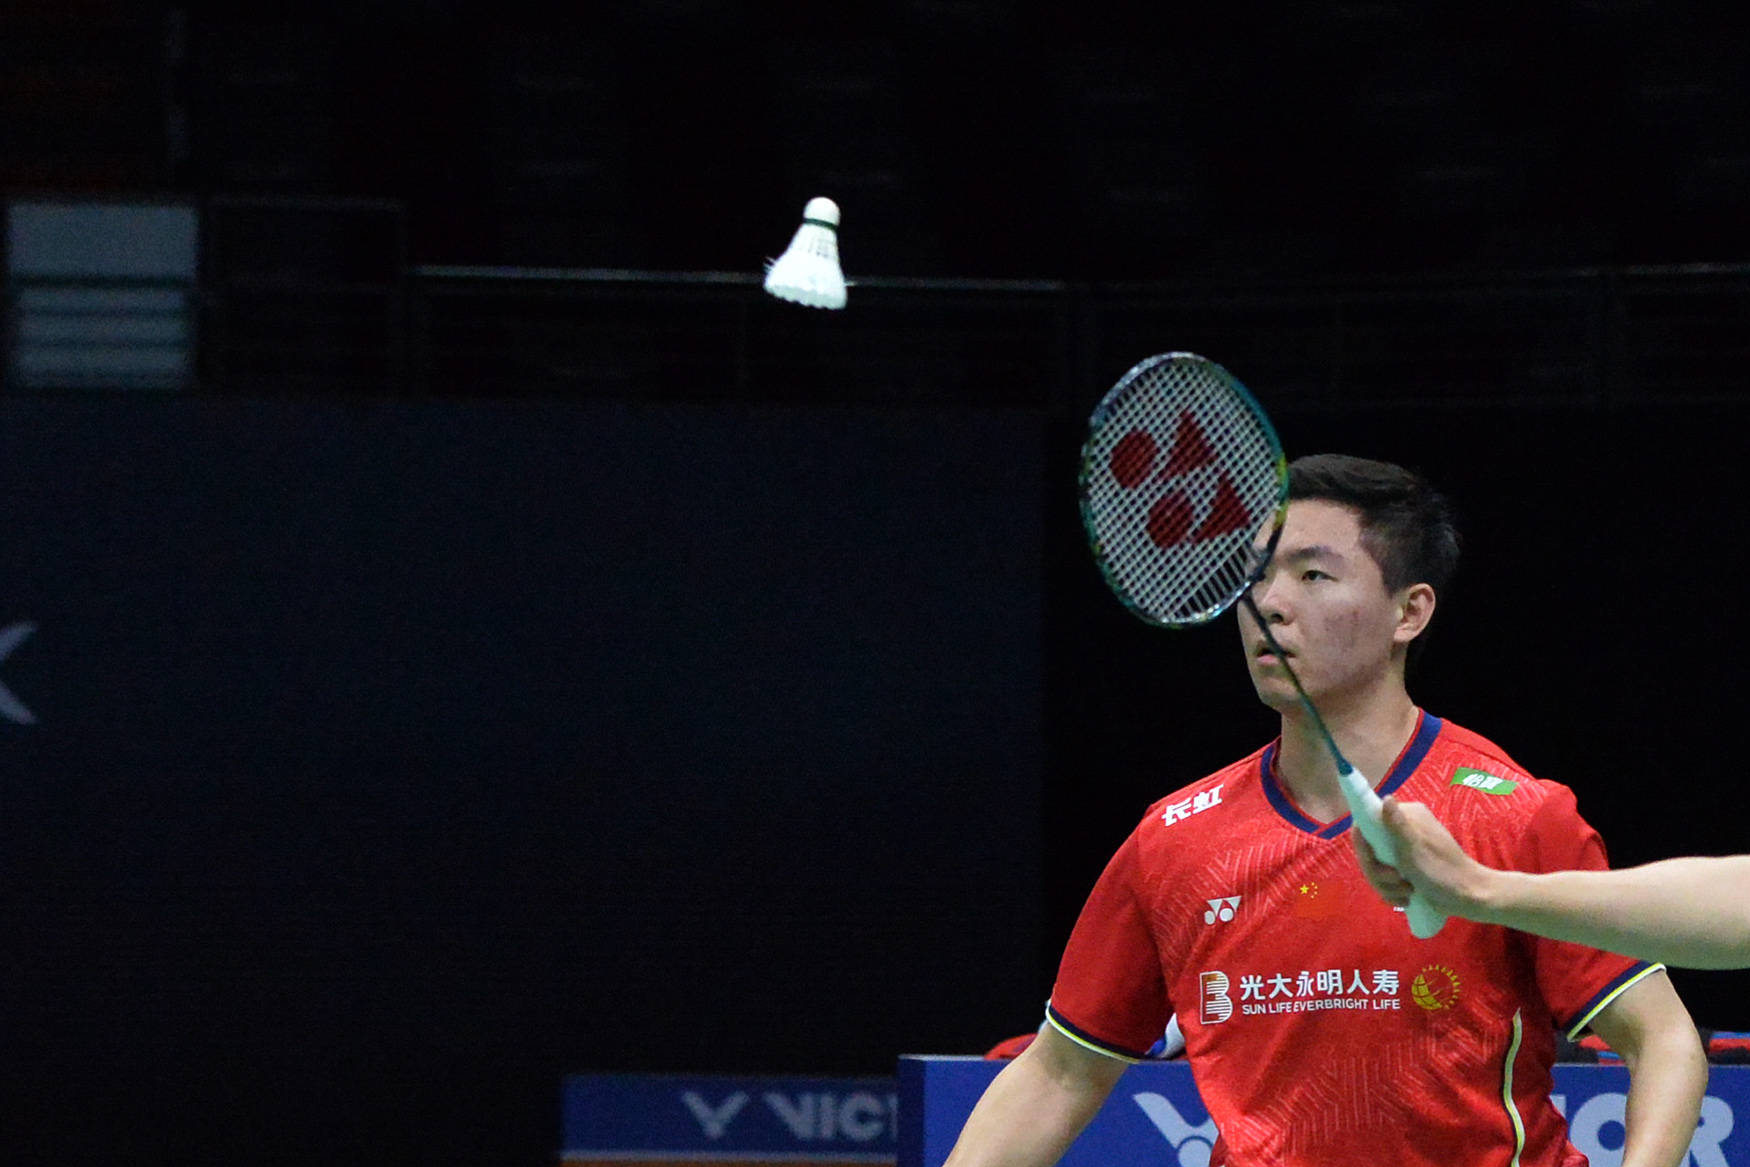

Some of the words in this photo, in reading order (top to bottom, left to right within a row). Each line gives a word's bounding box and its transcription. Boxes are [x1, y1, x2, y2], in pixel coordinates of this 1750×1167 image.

[1161, 783, 1224, 827] 长虹
[1240, 969, 1400, 1001] 光大永明人寿
[1242, 1003, 1267, 1015] SUN
[1269, 1001, 1292, 1014] LIFE
[1293, 998, 1369, 1012] EVERBRIGHT
[1373, 998, 1400, 1010] LIFE
